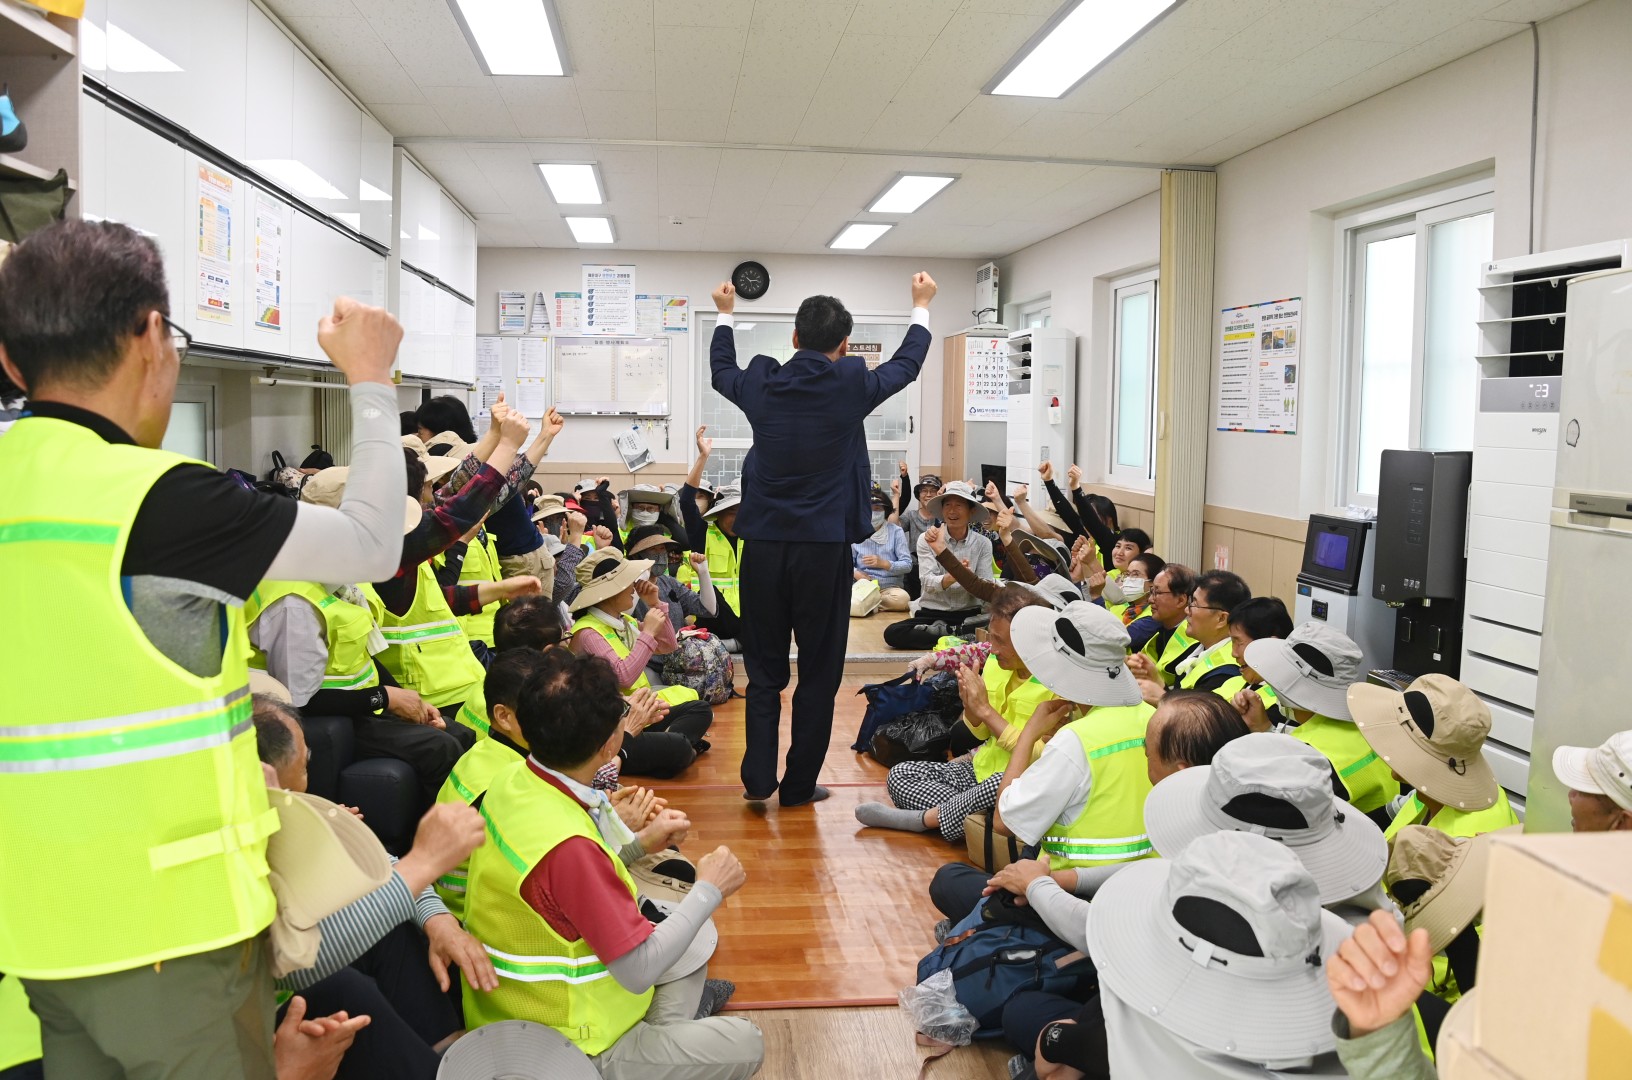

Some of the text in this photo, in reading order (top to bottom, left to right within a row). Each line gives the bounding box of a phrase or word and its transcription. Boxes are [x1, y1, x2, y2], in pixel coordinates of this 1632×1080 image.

[852, 344, 878, 352] 스트레칭
[991, 340, 998, 349] 7
[1535, 383, 1549, 398] 23
